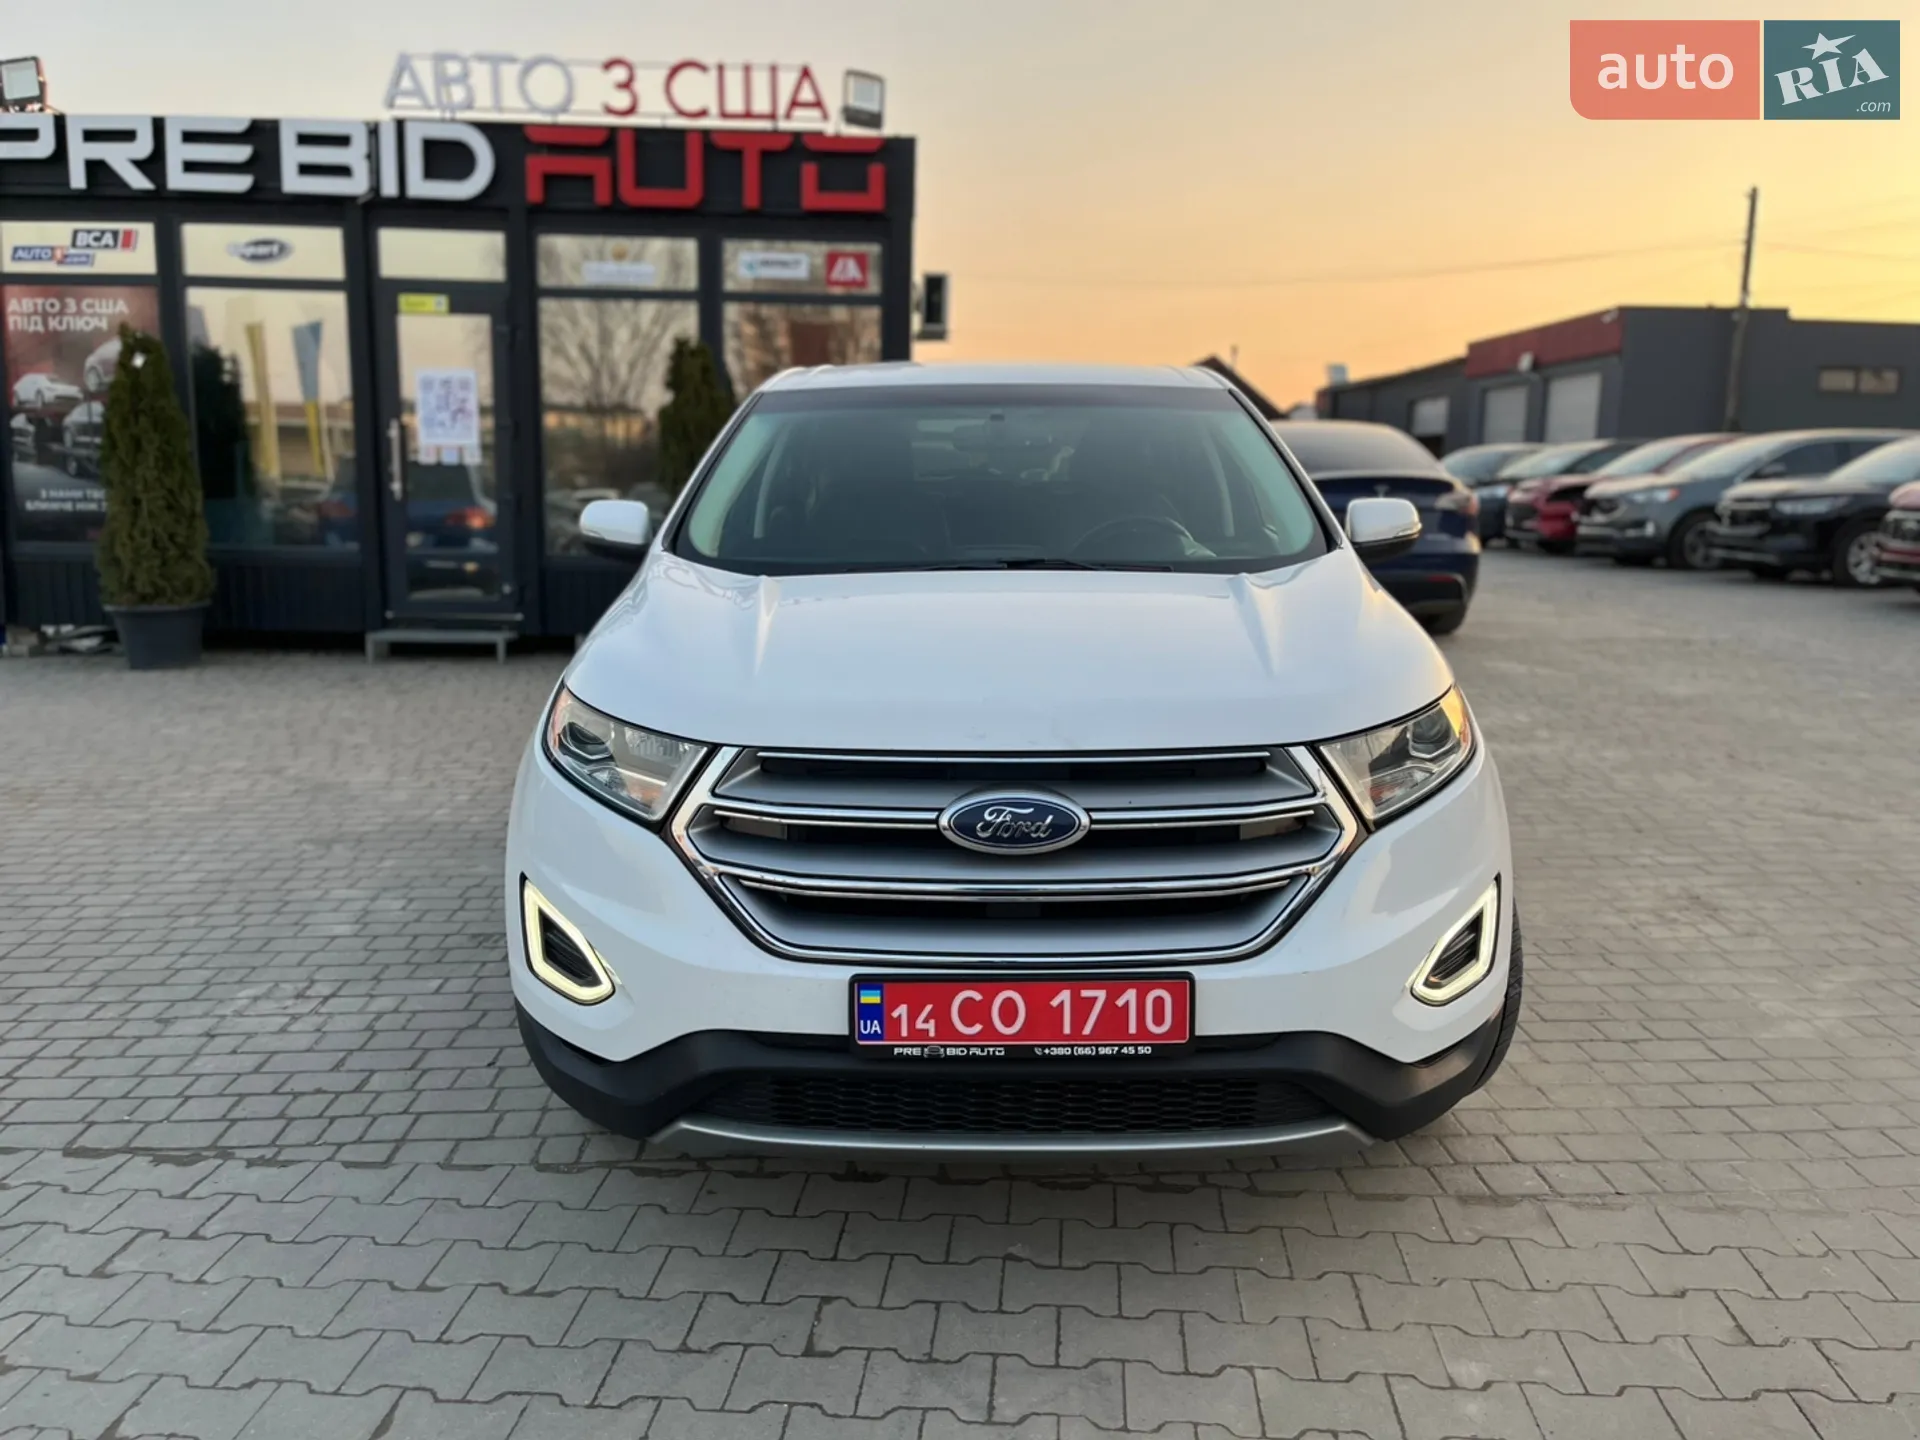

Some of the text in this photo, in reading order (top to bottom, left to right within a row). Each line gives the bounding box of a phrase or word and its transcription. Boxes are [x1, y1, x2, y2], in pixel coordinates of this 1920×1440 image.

[383, 52, 575, 115] АВТО
[664, 60, 829, 121] США
[0, 114, 885, 213] PRE BID AUTO
[74, 231, 115, 247] BCA
[8, 298, 60, 314] АВТО
[82, 298, 130, 315] США
[9, 316, 108, 333] ПІД КЛЮЧ
[976, 806, 1054, 838] Ford
[891, 988, 1173, 1037] 14 CO 1710
[860, 1020, 881, 1035] UA
[894, 1047, 1005, 1056] PRE BID AUTO
[1043, 1045, 1152, 1056] +380 (66) 967 45 50
